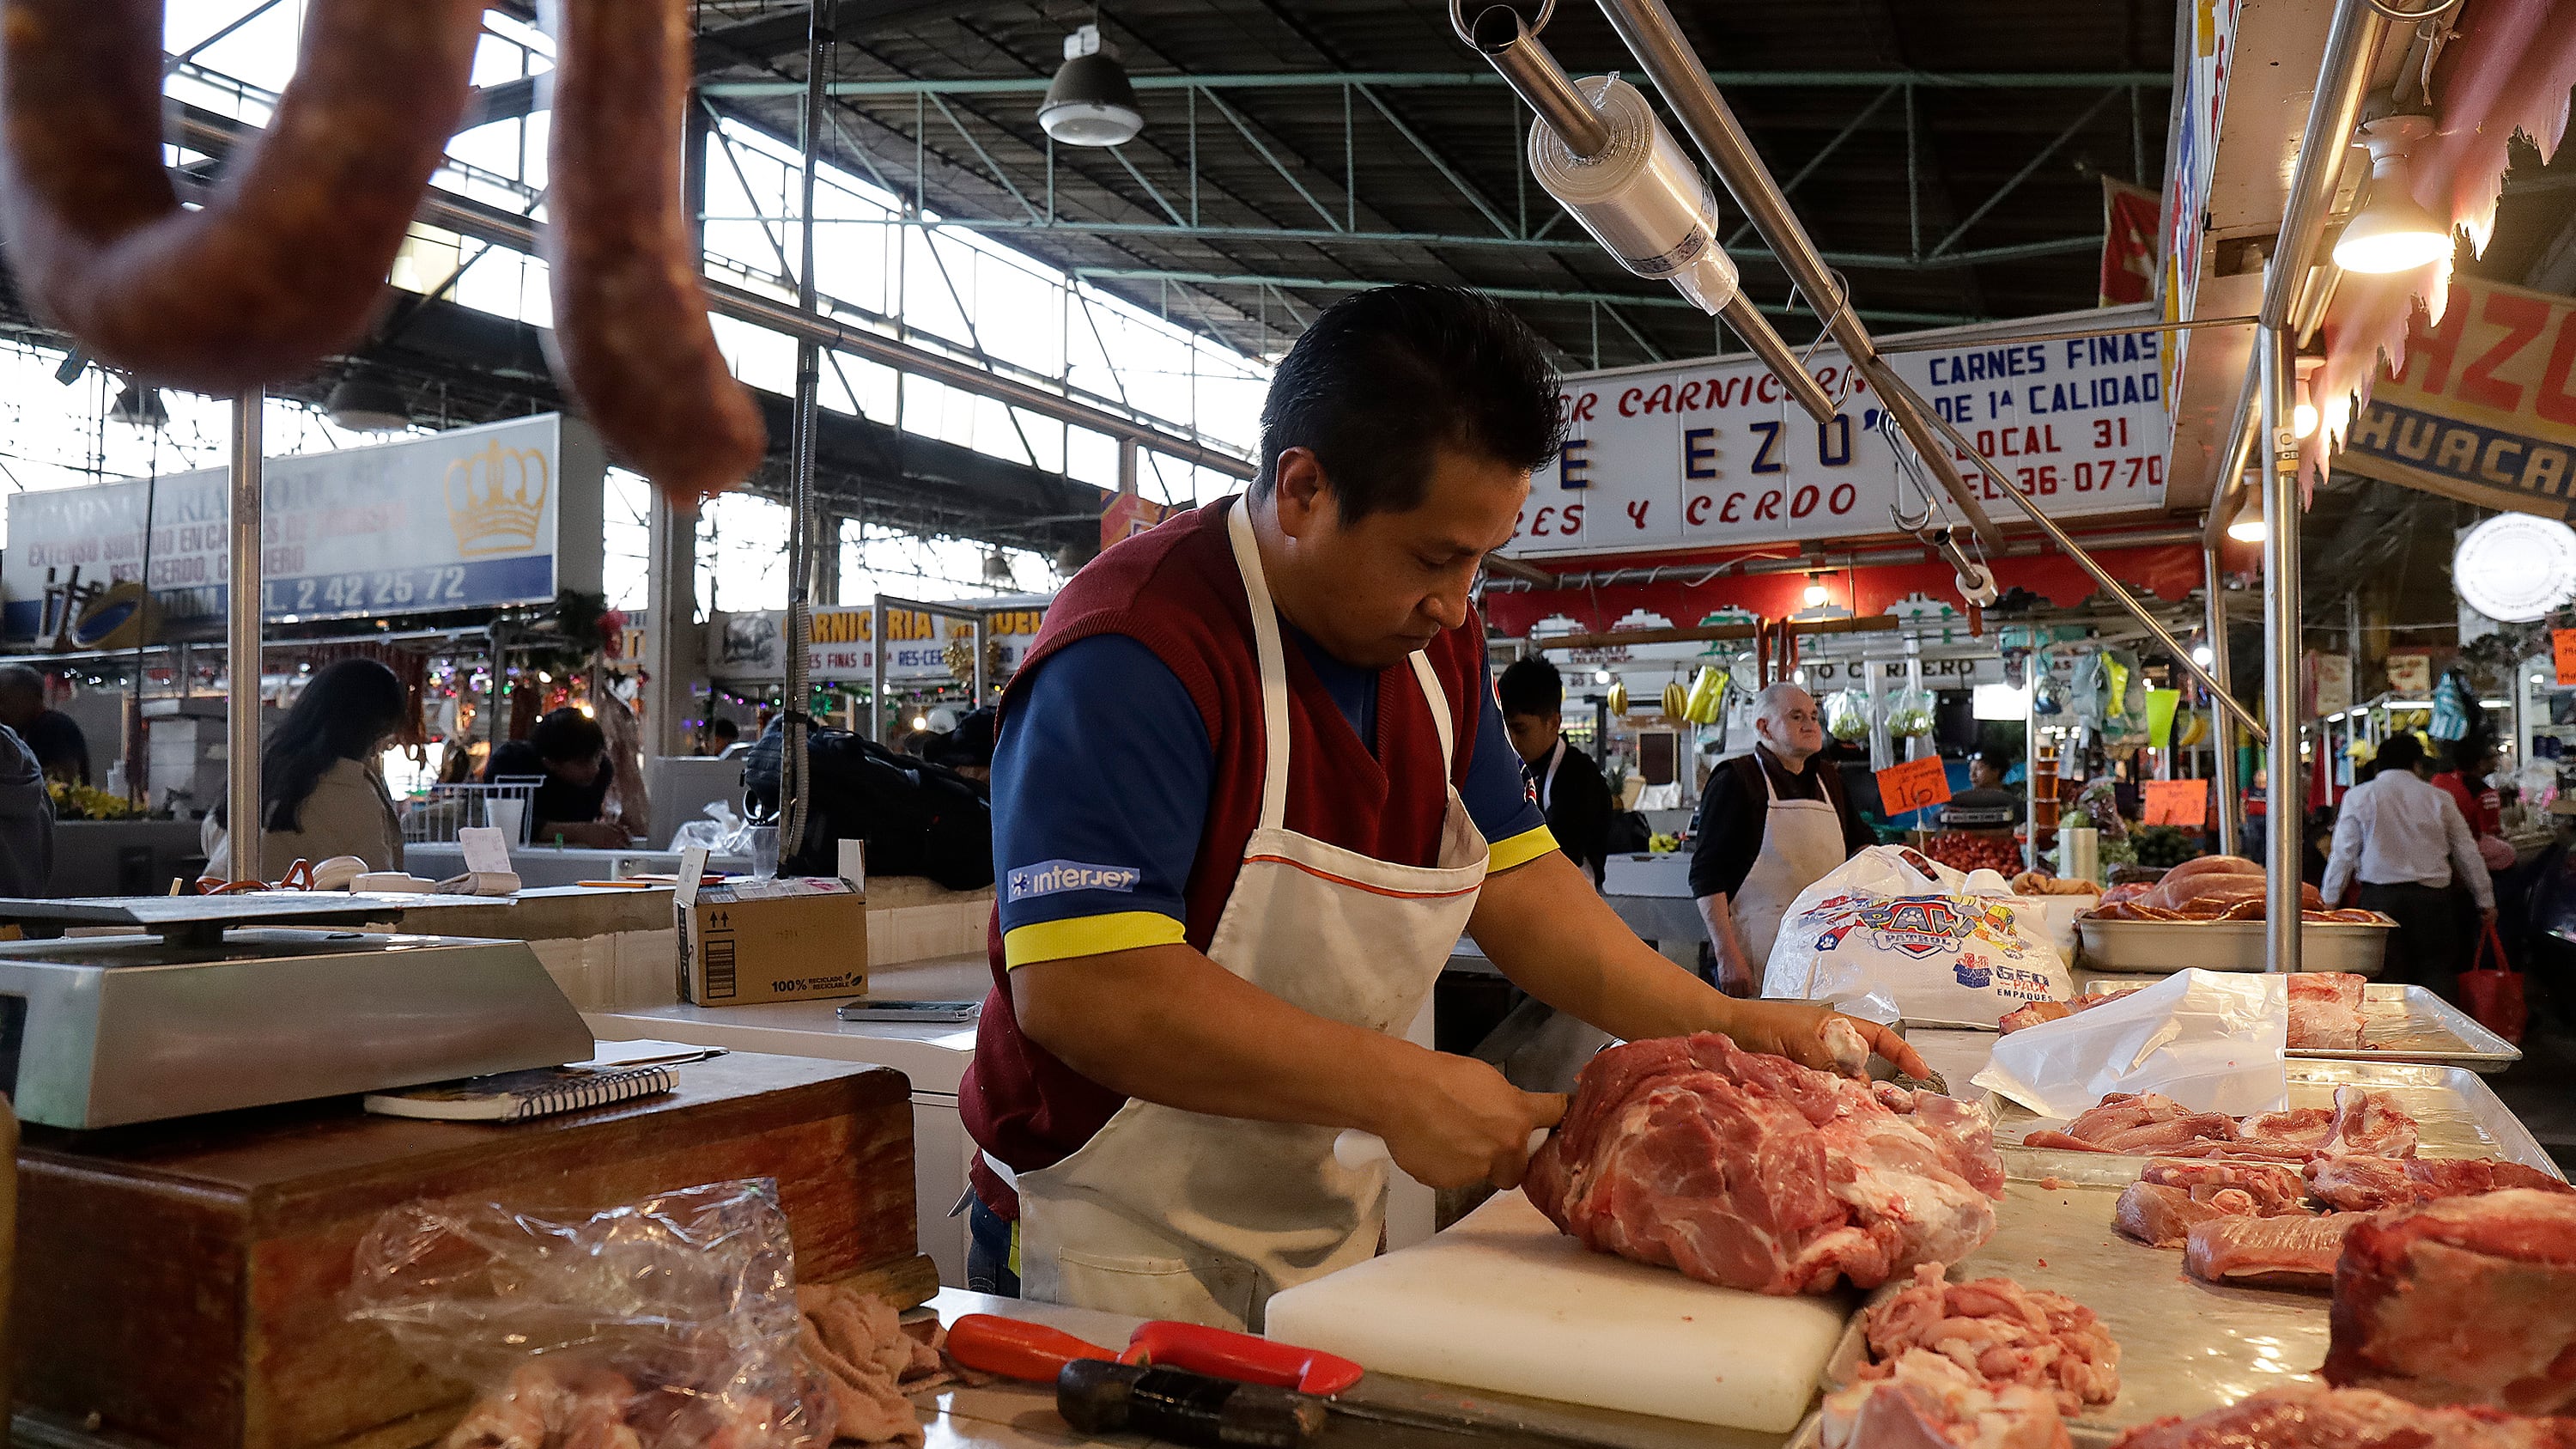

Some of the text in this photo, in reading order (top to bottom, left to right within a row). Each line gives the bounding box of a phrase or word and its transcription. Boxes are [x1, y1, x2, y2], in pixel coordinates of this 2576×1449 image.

[1929, 332, 2157, 387] CARNES FINAS
[1935, 394, 1973, 423] DE
[2028, 373, 2160, 415] CALIDAD
[2093, 417, 2128, 449] 31
[1686, 483, 1856, 527] CERDO
[297, 578, 317, 610] 2
[324, 575, 364, 607] 42
[373, 571, 414, 604] 25
[424, 563, 466, 601] 72
[827, 652, 857, 669] FINAS
[1859, 905, 1978, 939] PAW
[1884, 934, 1952, 947] PATROL
[771, 978, 808, 993] 100%
[1996, 988, 2054, 1002] EMPAQUES
